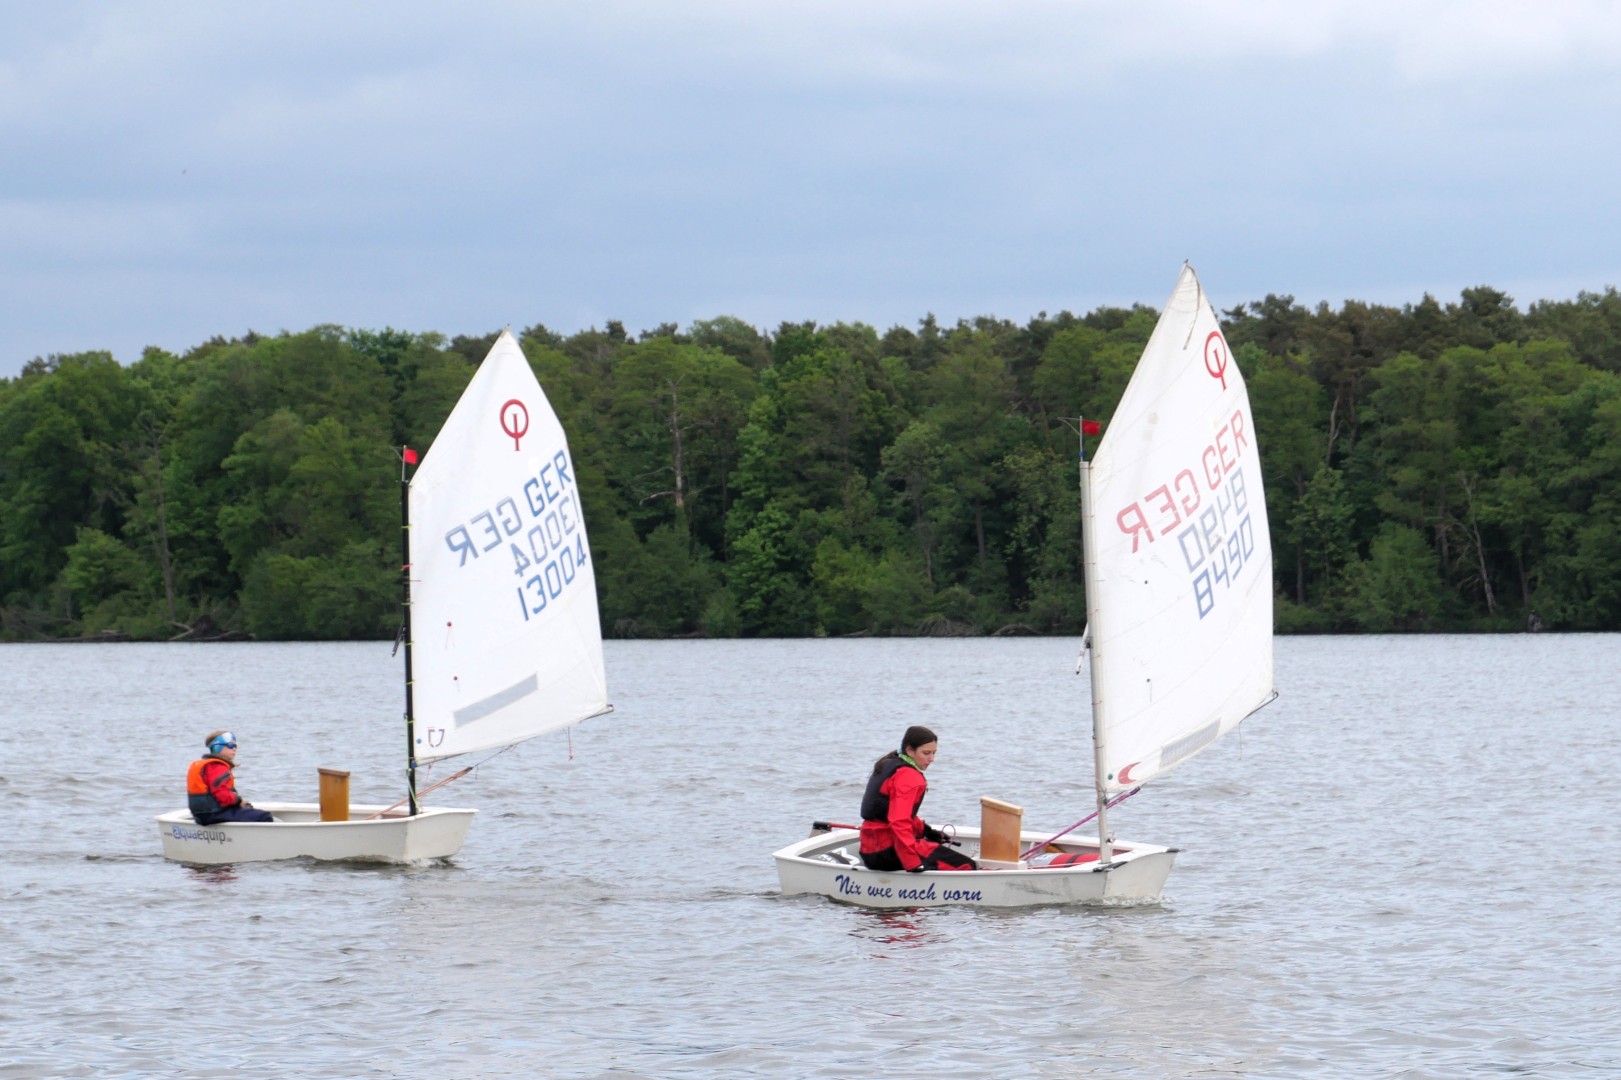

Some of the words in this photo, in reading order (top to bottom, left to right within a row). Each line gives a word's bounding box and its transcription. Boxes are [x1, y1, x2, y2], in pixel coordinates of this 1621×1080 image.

[523, 449, 572, 518] GER
[1202, 409, 1248, 491] GER
[517, 532, 587, 622] 13004
[1193, 512, 1254, 620] 8490
[835, 874, 861, 896] Nix
[867, 884, 893, 898] wie
[898, 882, 937, 901] nach
[943, 888, 982, 902] vorn
